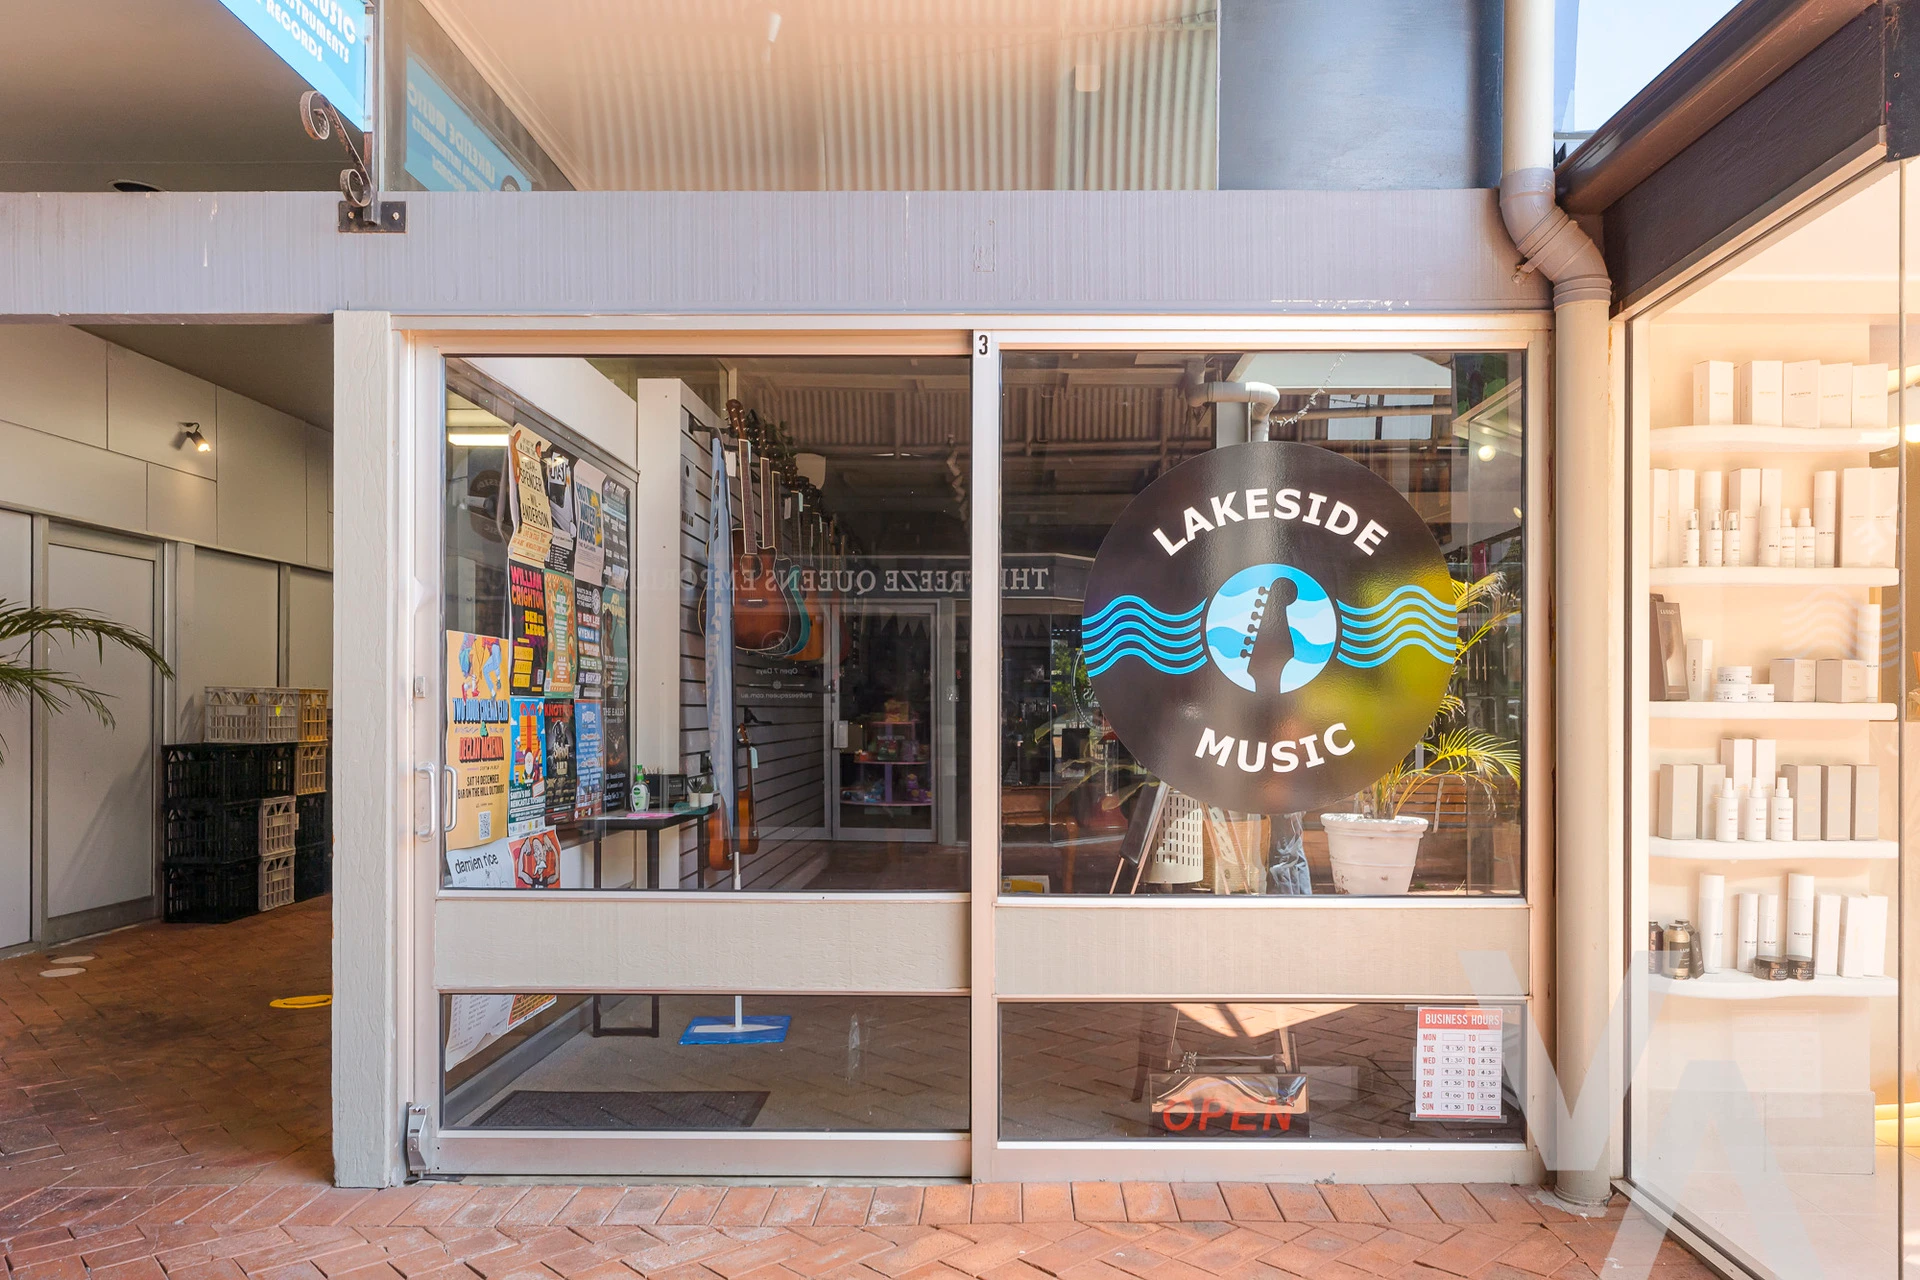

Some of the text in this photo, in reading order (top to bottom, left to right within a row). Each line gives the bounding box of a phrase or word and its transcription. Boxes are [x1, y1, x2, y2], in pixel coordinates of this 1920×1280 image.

[266, 0, 323, 62] RECORDS
[284, 0, 350, 64] STRUMENTS
[978, 334, 989, 356] 3
[1152, 488, 1389, 557] LAKESIDE
[510, 565, 542, 591] WILLIAM
[512, 584, 544, 611] CRIGHTON
[1194, 722, 1356, 773] MUSIC
[466, 776, 474, 786] SAT
[480, 774, 500, 785] DECEMBER
[455, 852, 498, 874] damien rice
[1425, 1014, 1500, 1026] BUSINESS HOURS
[1162, 1096, 1294, 1132] OPEN
